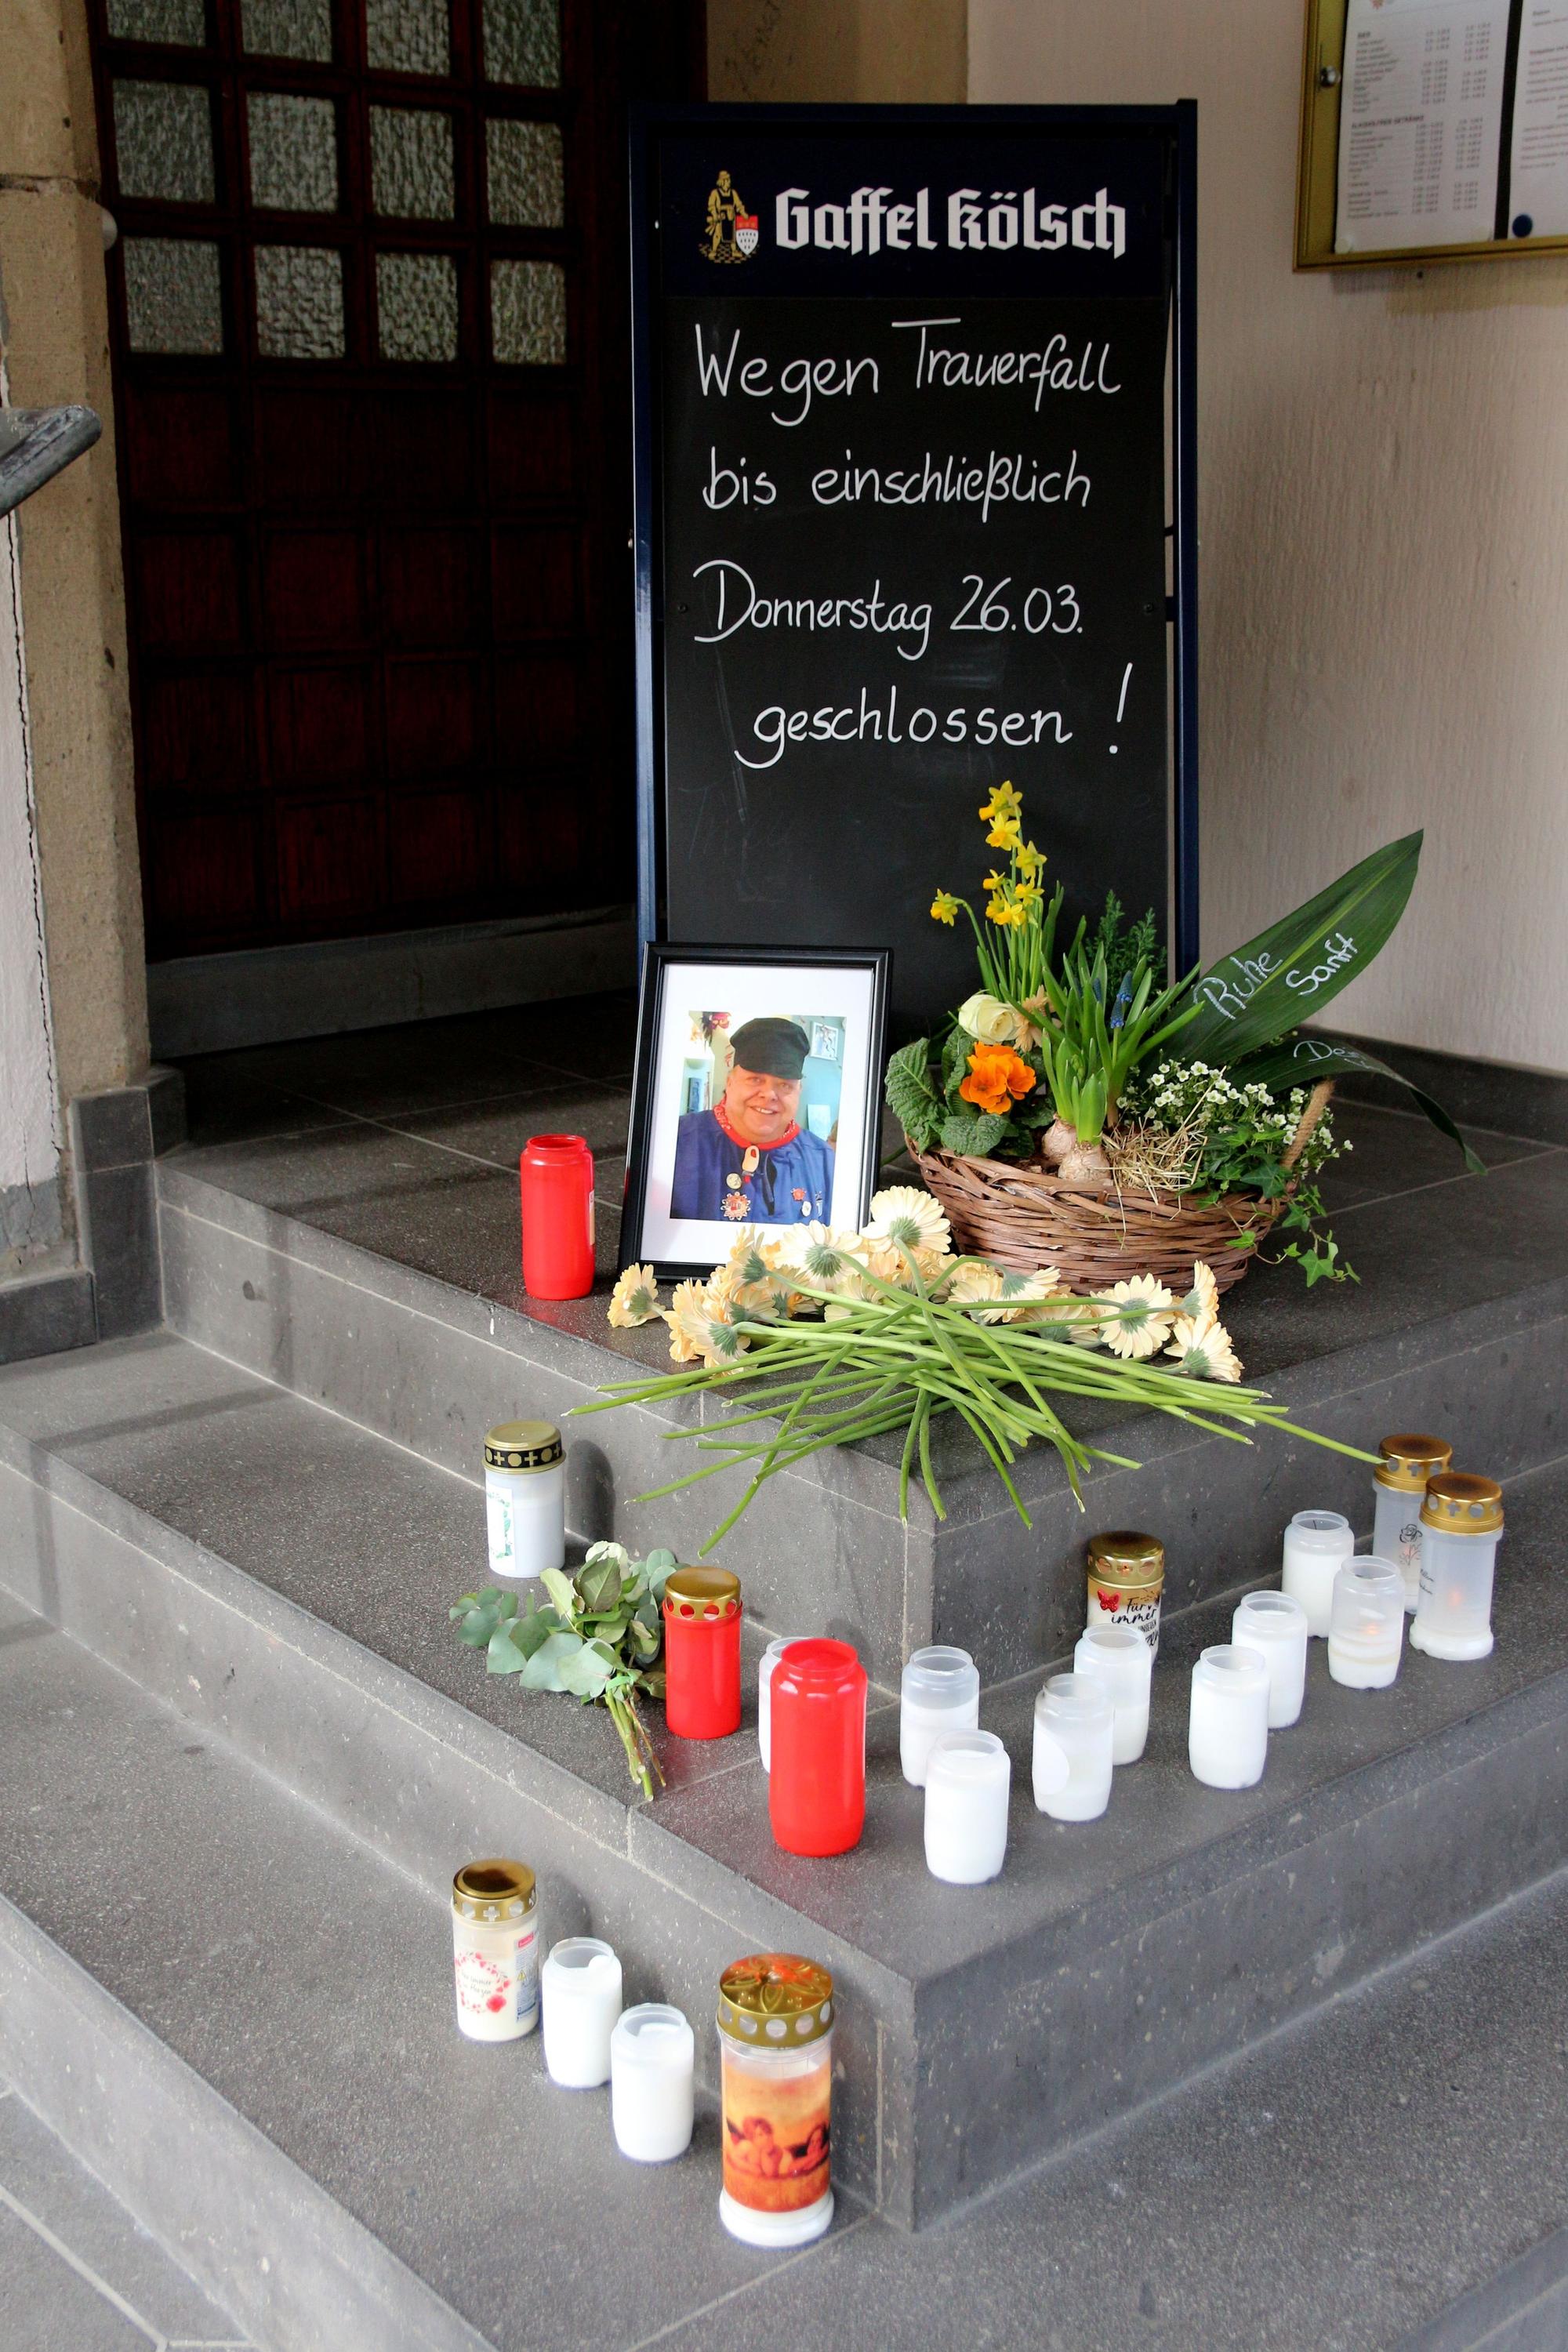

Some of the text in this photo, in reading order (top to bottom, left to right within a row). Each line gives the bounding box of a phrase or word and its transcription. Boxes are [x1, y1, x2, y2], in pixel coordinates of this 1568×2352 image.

[775, 187, 1126, 260] Gaffel Kölsch
[695, 318, 1121, 426] Wegen Trauerfall
[702, 446, 1091, 523] bis einschließlich
[692, 559, 1083, 661] Donnerstag 26.03.
[734, 684, 1073, 769] geschlossen
[1192, 951, 1283, 1020] Ruhe
[1285, 931, 1359, 996] Sanft
[1111, 1608, 1157, 1624] immer
[1127, 1596, 1147, 1614] Für
